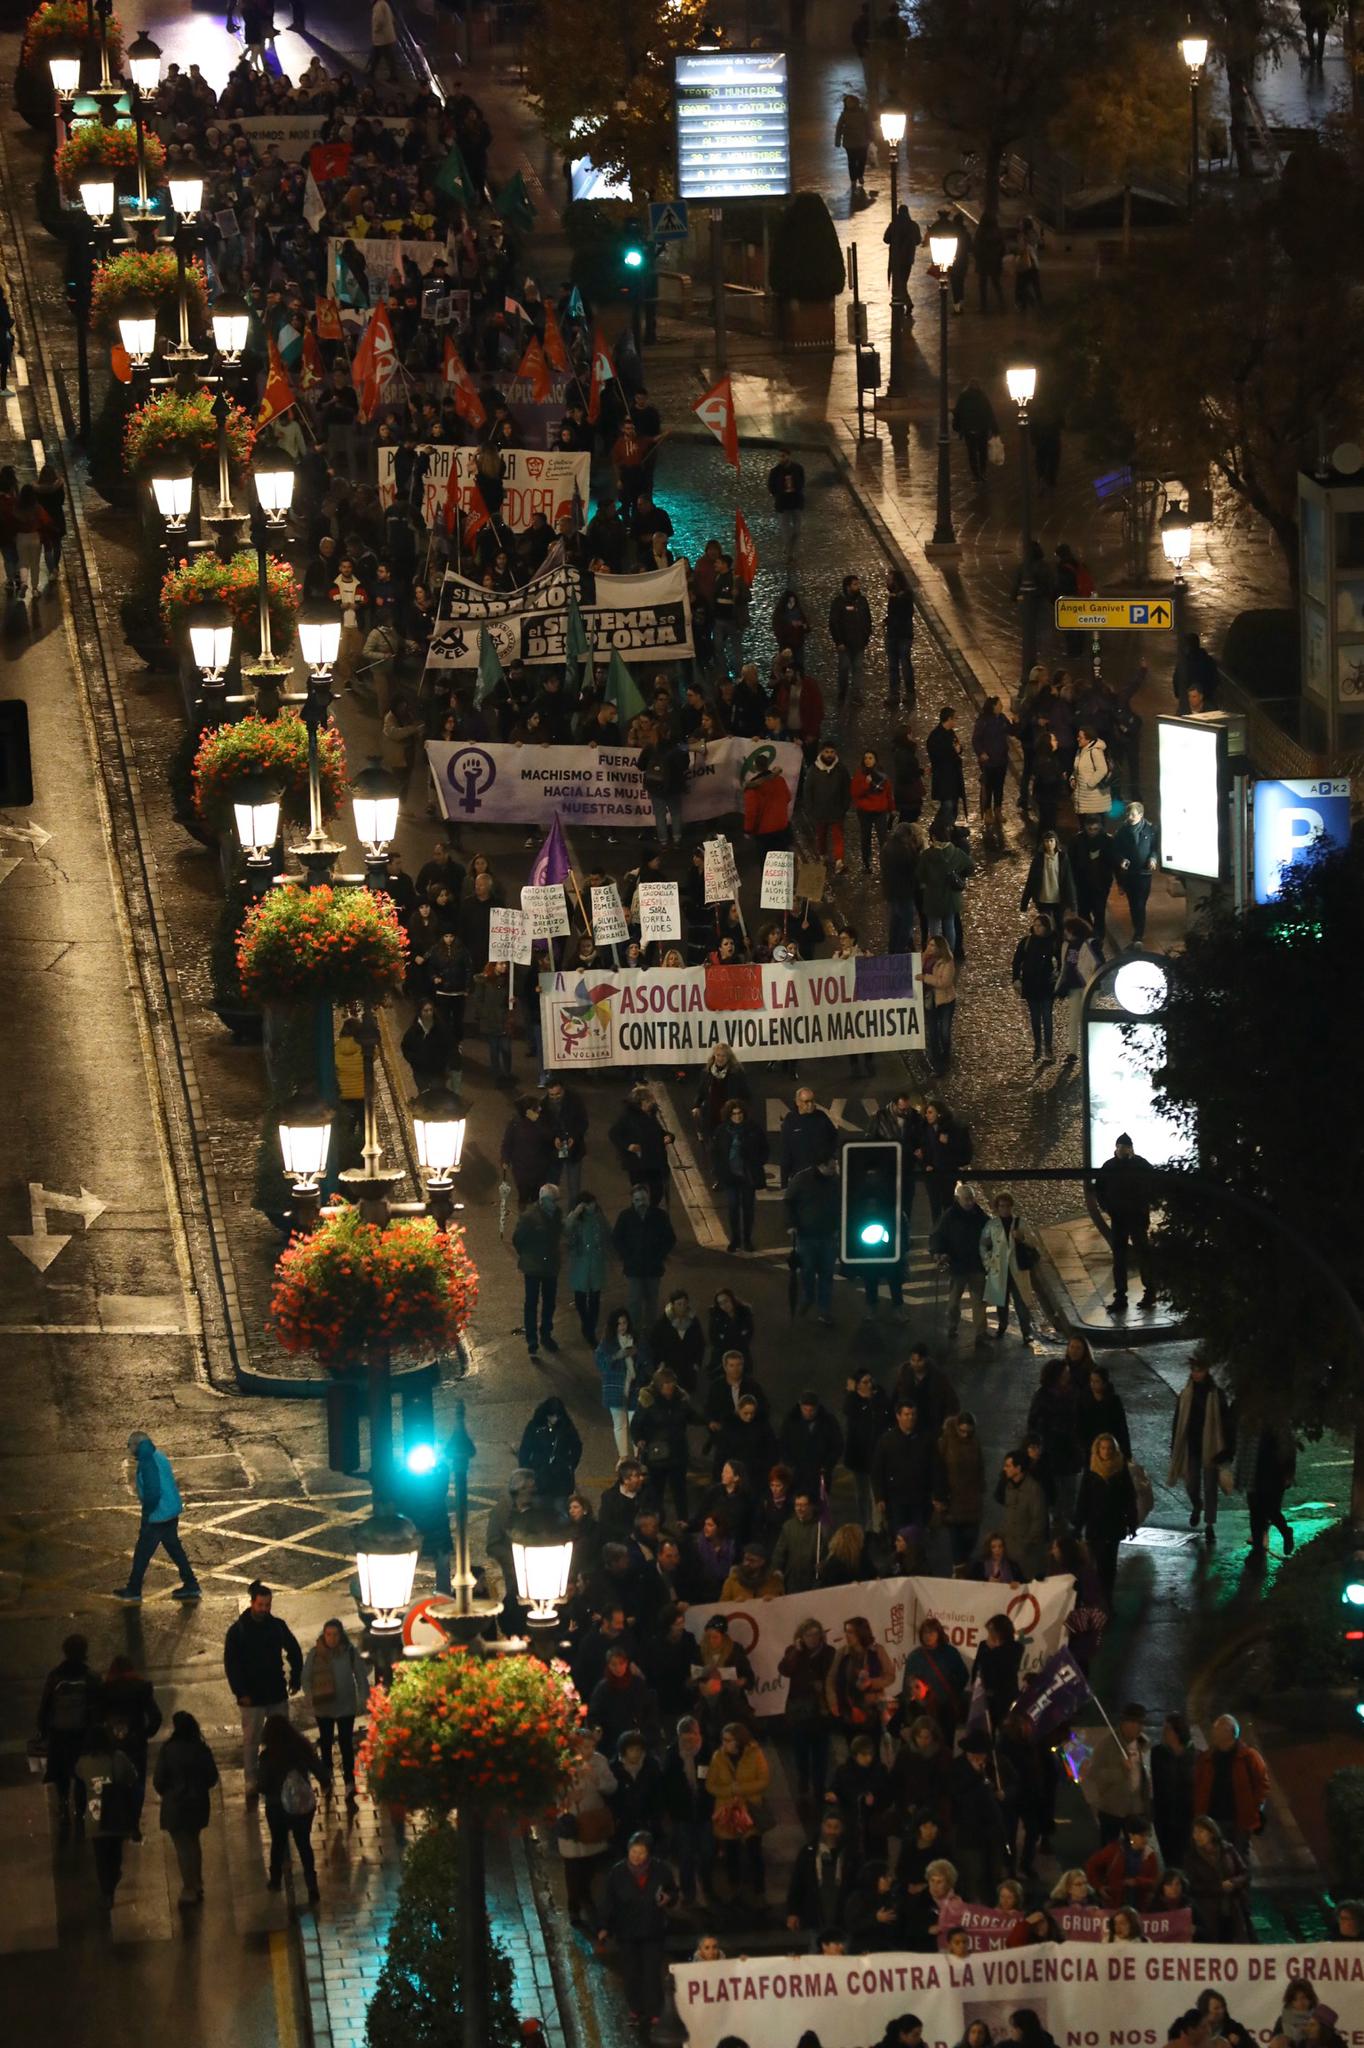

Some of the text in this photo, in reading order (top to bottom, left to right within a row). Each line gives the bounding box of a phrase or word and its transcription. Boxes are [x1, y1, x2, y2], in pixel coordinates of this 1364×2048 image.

[684, 85, 778, 97] TEATRO MUNICIPAL
[1061, 602, 1125, 614] Ángel Ganivet
[528, 624, 541, 637] el
[543, 610, 657, 637] SITEMA
[1079, 615, 1106, 623] centro
[527, 624, 678, 657] DEPLOMA
[598, 754, 641, 767] FUERA
[521, 769, 593, 781] MACHISMO
[596, 771, 603, 781] E
[544, 786, 652, 800] HACIA LAS MUJE
[561, 802, 633, 815] NUESTRAS
[619, 984, 704, 1014] ASOCIA
[770, 979, 800, 1009] LA
[619, 1007, 920, 1051] CONTRA LA VIOLENCIA MACHISTA
[687, 1972, 839, 2004] PLATAFORMA
[852, 1964, 941, 2000] CONTRA
[949, 1964, 976, 1989] LA
[983, 1957, 1099, 1987] VIOLENCIA
[1108, 1957, 1136, 1981] DE
[1145, 1956, 1239, 1982] GENERO
[1249, 1957, 1277, 1980] DE
[1066, 2028, 1155, 2047] NO NOS
